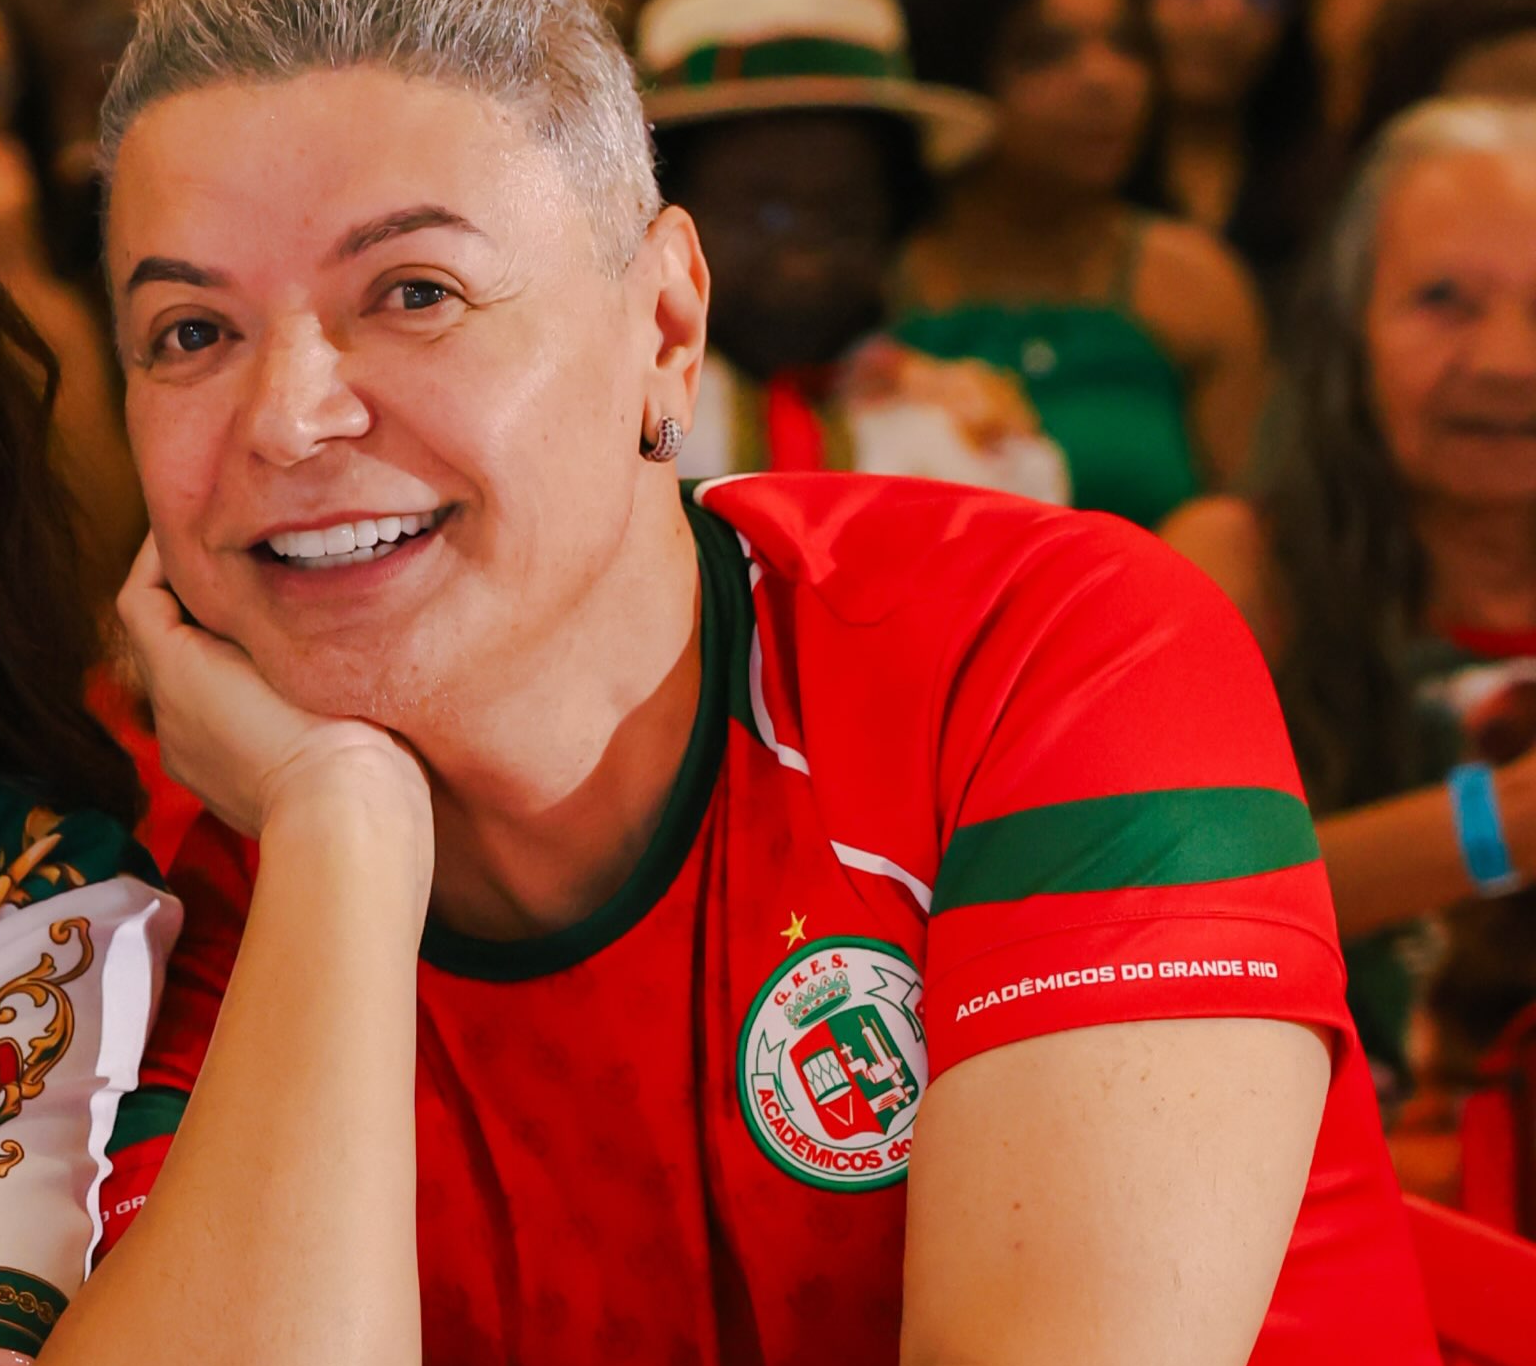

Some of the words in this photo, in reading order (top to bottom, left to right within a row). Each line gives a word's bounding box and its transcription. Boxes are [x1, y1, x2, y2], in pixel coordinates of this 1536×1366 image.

[956, 965, 1115, 1022] ACADÊMICOS
[1120, 962, 1154, 981] DO
[1158, 960, 1244, 978] GRANDE
[1247, 960, 1278, 978] RIO
[757, 1088, 883, 1172] ACADÊMICOS
